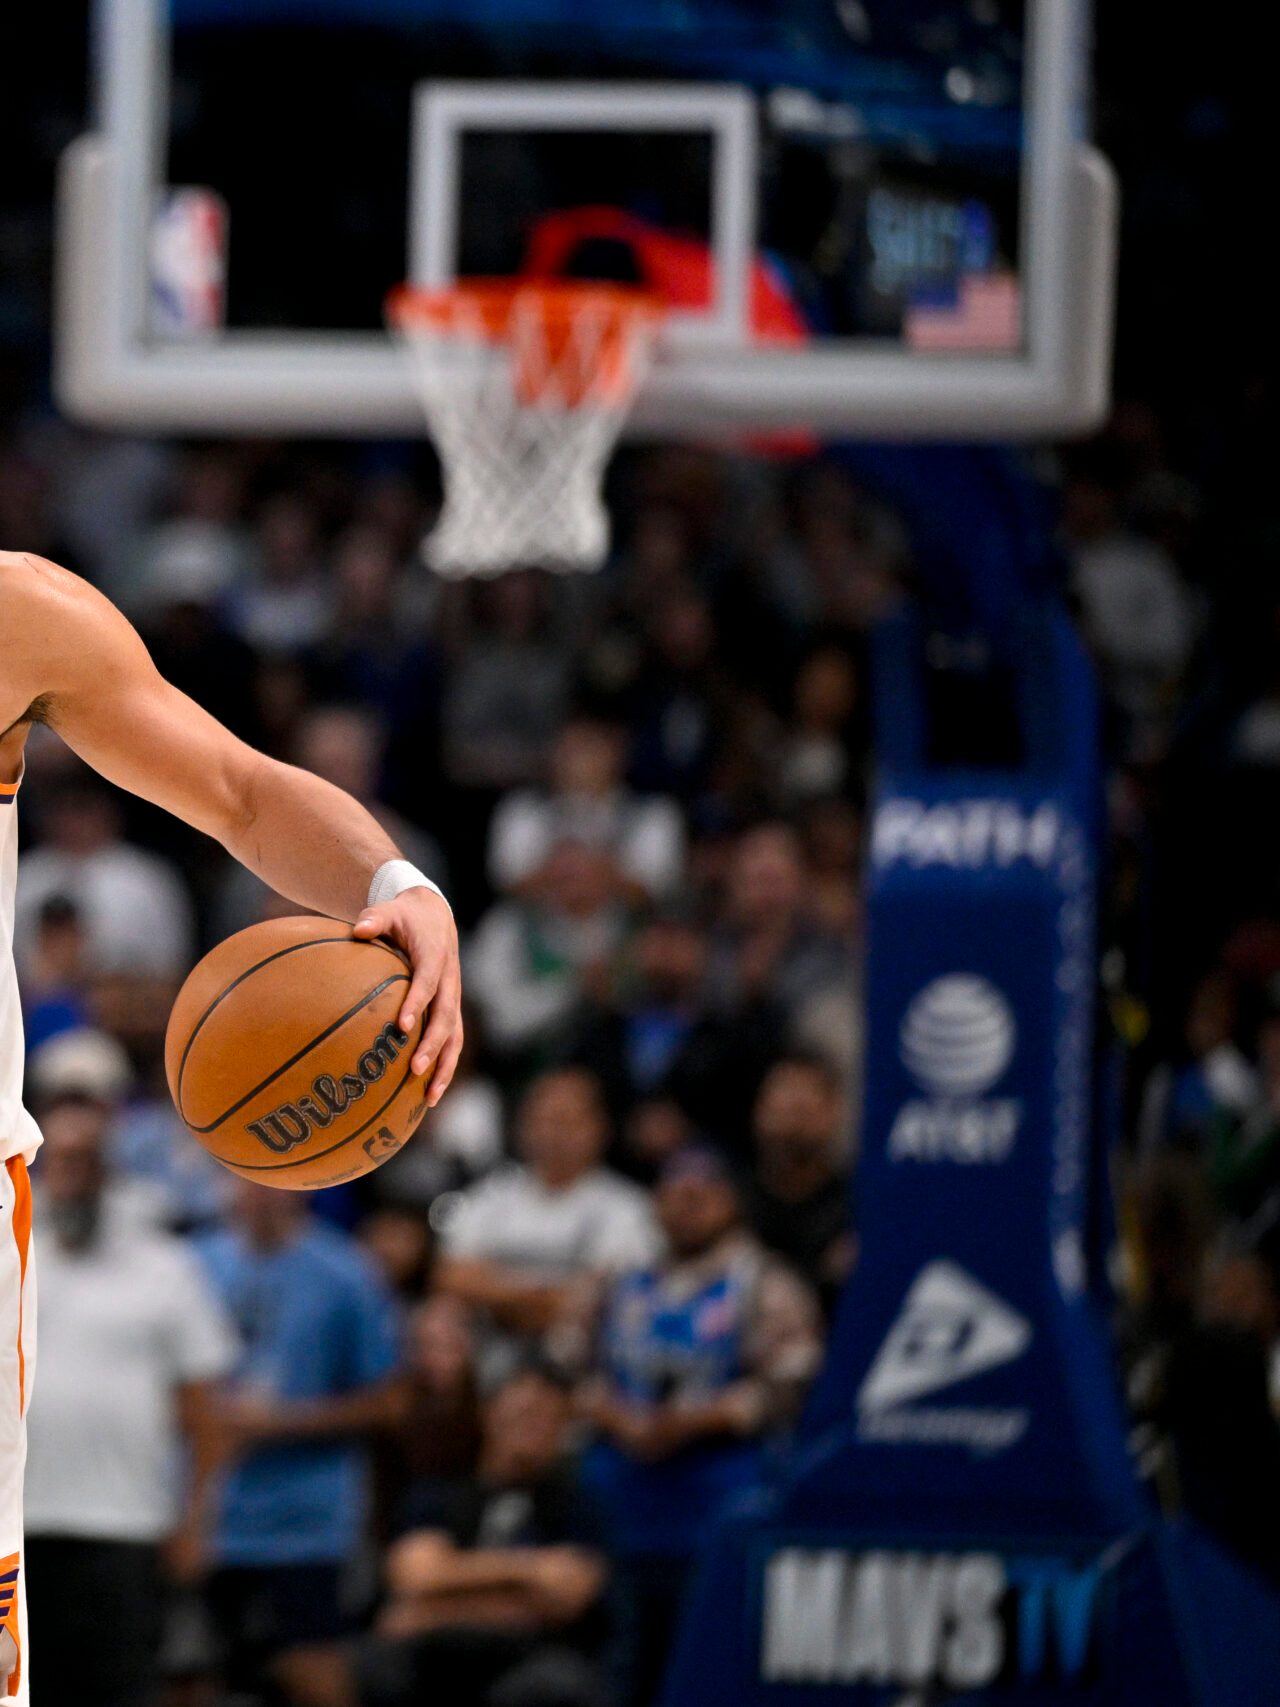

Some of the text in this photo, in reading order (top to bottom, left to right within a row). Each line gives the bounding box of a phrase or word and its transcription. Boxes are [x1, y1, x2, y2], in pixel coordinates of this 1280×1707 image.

[872, 800, 1059, 868] PATH
[244, 1021, 410, 1154] Wilson
[887, 1100, 1021, 1164] AT&T
